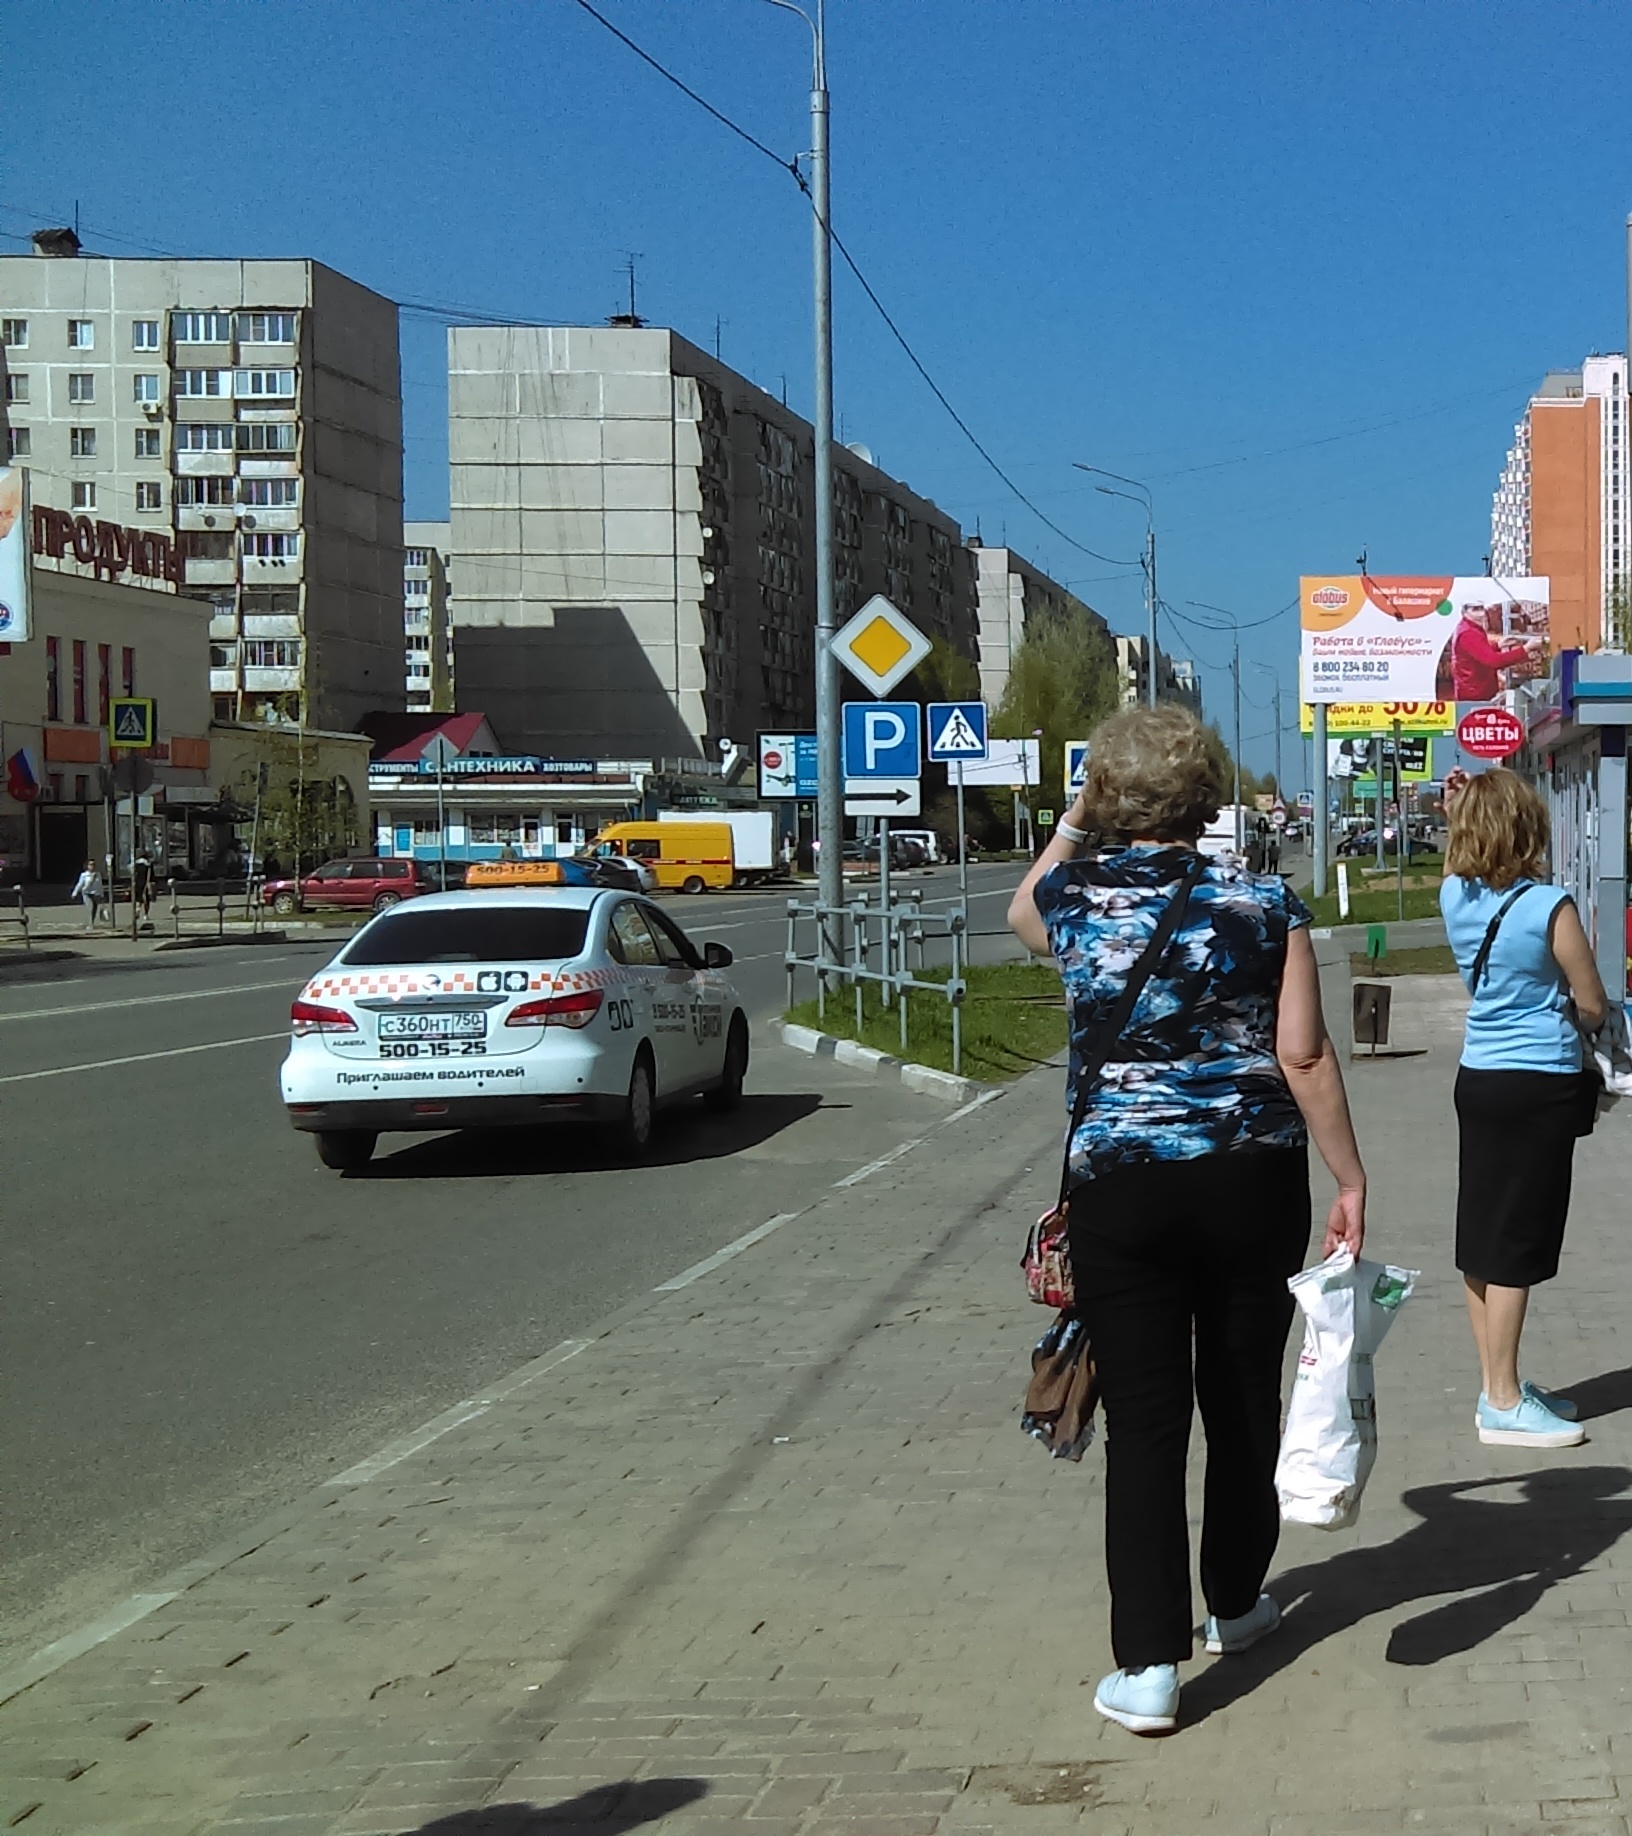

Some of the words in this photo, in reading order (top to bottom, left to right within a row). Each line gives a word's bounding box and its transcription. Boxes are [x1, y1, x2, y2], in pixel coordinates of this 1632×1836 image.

[33, 505, 186, 583] ПРОДУКТЫ
[1312, 636, 1354, 647] Работа
[1357, 636, 1364, 647] в
[1367, 636, 1422, 649] «Глобус»
[1313, 661, 1319, 672] 8
[1321, 661, 1340, 672] 800
[1342, 661, 1359, 672] 234
[1377, 661, 1389, 672] 20
[1462, 727, 1518, 743] ЦВЕТЫ
[369, 762, 419, 773] СТРУМЕНТЫ
[424, 760, 536, 773] СНТЕХНИКА
[542, 762, 593, 772] ХОЗТОВАРЫ
[477, 864, 551, 875] 500-15-25
[455, 1012, 481, 1027] 750
[379, 1041, 487, 1058] 500-15-25
[336, 1071, 434, 1086] Приглашаем
[437, 1066, 525, 1080] водителей
